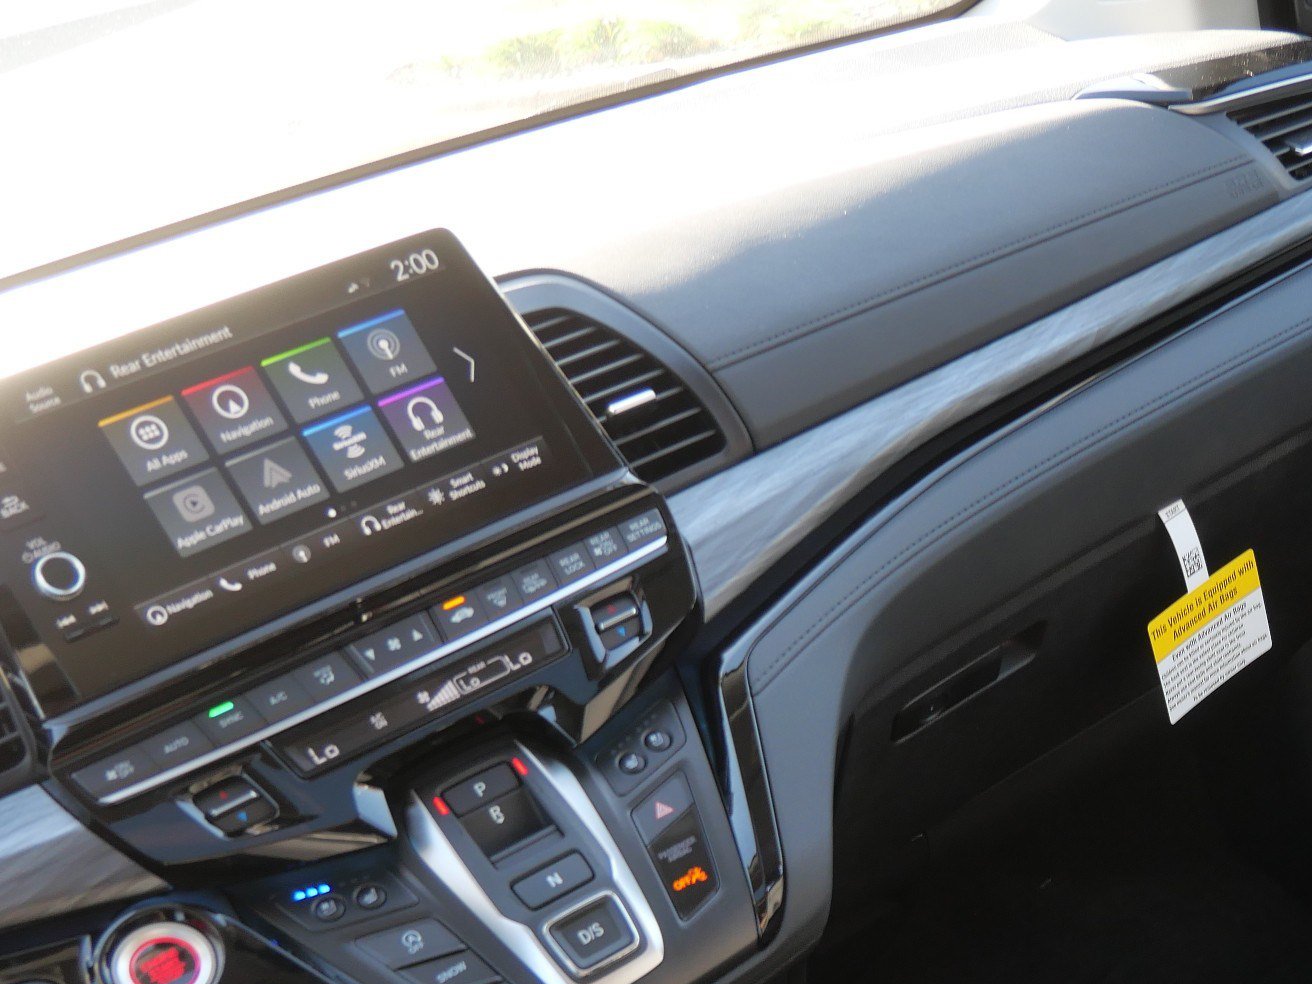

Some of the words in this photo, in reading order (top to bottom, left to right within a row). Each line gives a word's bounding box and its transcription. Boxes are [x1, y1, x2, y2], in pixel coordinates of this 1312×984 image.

[390, 249, 439, 282] 2:00
[109, 361, 142, 379] Rear
[142, 325, 234, 368] Entertainment
[389, 362, 408, 379] FM
[308, 390, 341, 410] Phone
[220, 416, 275, 444] Navigation
[423, 425, 446, 441] Rear
[408, 427, 475, 462] Entertainment
[146, 456, 161, 473] All
[161, 450, 189, 468] Apps
[343, 455, 387, 481] SiriusXM
[258, 491, 297, 516] Android
[297, 483, 322, 502] Auto
[177, 530, 207, 550] Apple
[205, 514, 244, 537] CarPlay
[563, 560, 587, 577] LOCK
[1151, 624, 1167, 641] This
[1167, 602, 1194, 628] Vehicle
[1195, 597, 1203, 609] is
[1203, 570, 1237, 602] Equipped
[1237, 559, 1255, 577] with
[1173, 610, 1207, 641] Advanced
[1208, 601, 1218, 614] Air
[1219, 586, 1238, 605] Bags
[307, 743, 341, 766] Lo
[472, 780, 487, 799] P
[547, 871, 564, 888] N
[576, 921, 606, 946] D/S
[436, 960, 467, 984] SNOW
